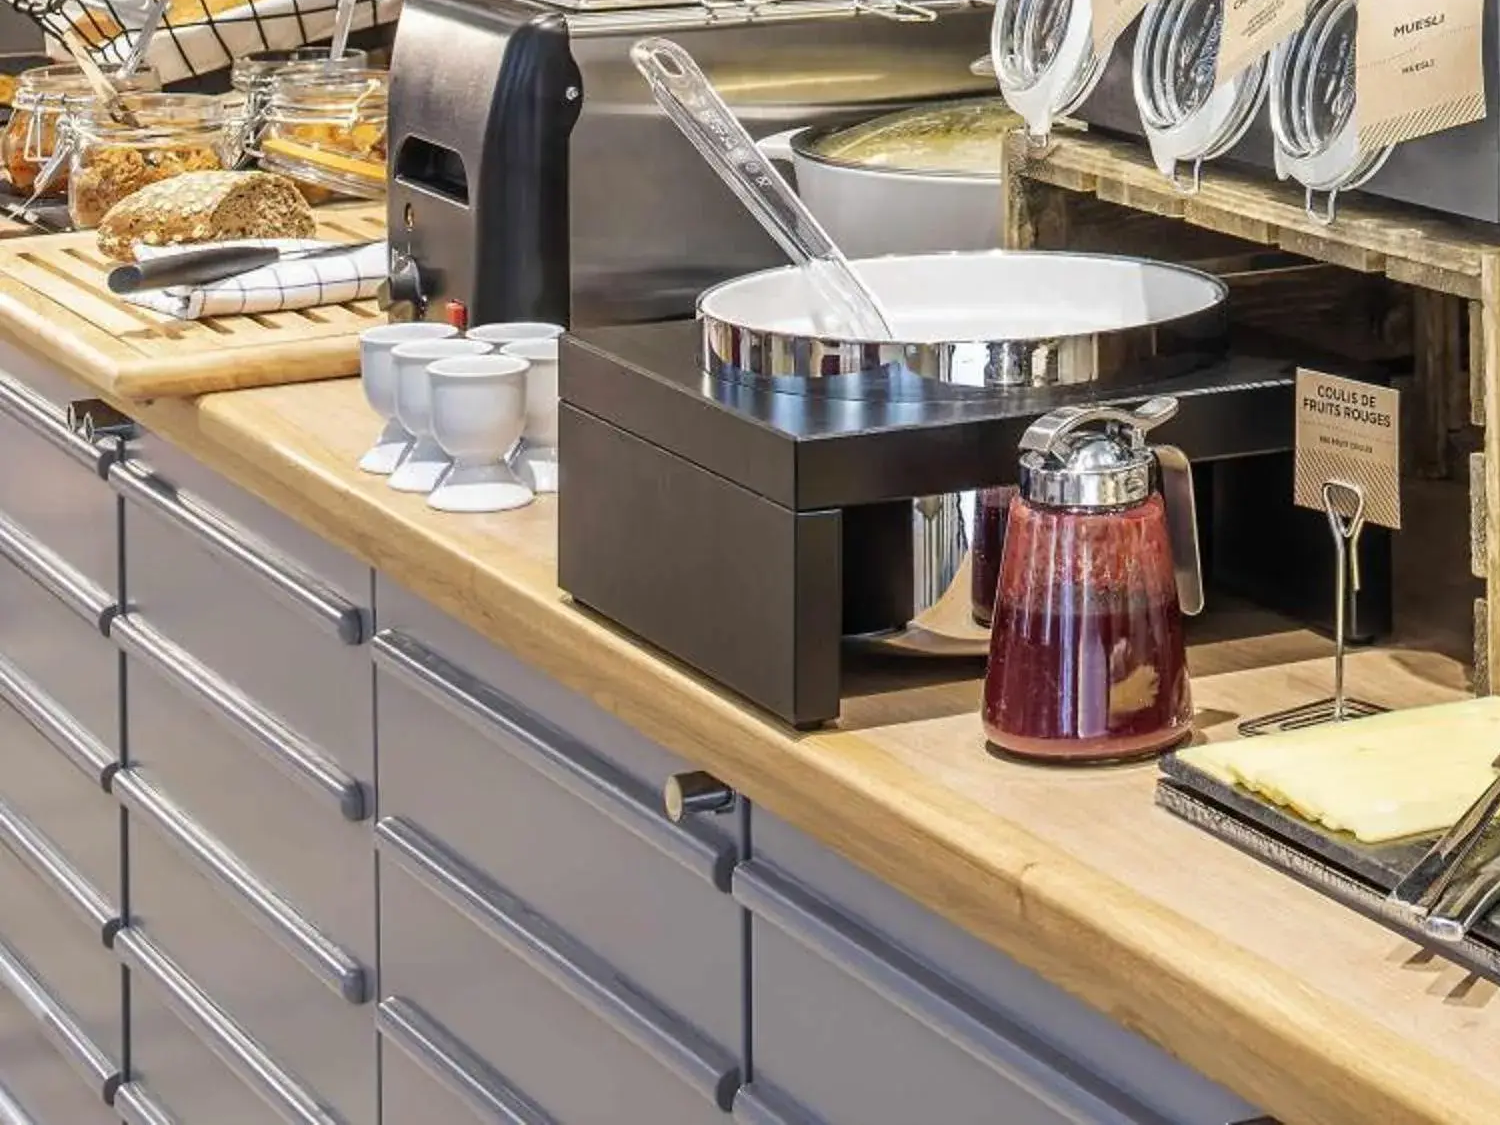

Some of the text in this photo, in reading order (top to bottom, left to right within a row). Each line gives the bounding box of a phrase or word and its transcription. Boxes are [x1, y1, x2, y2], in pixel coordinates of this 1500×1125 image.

[1393, 13, 1445, 38] MUESLI
[1317, 384, 1376, 408] COULIS DE
[1303, 397, 1391, 428] FRUITS ROUGES
